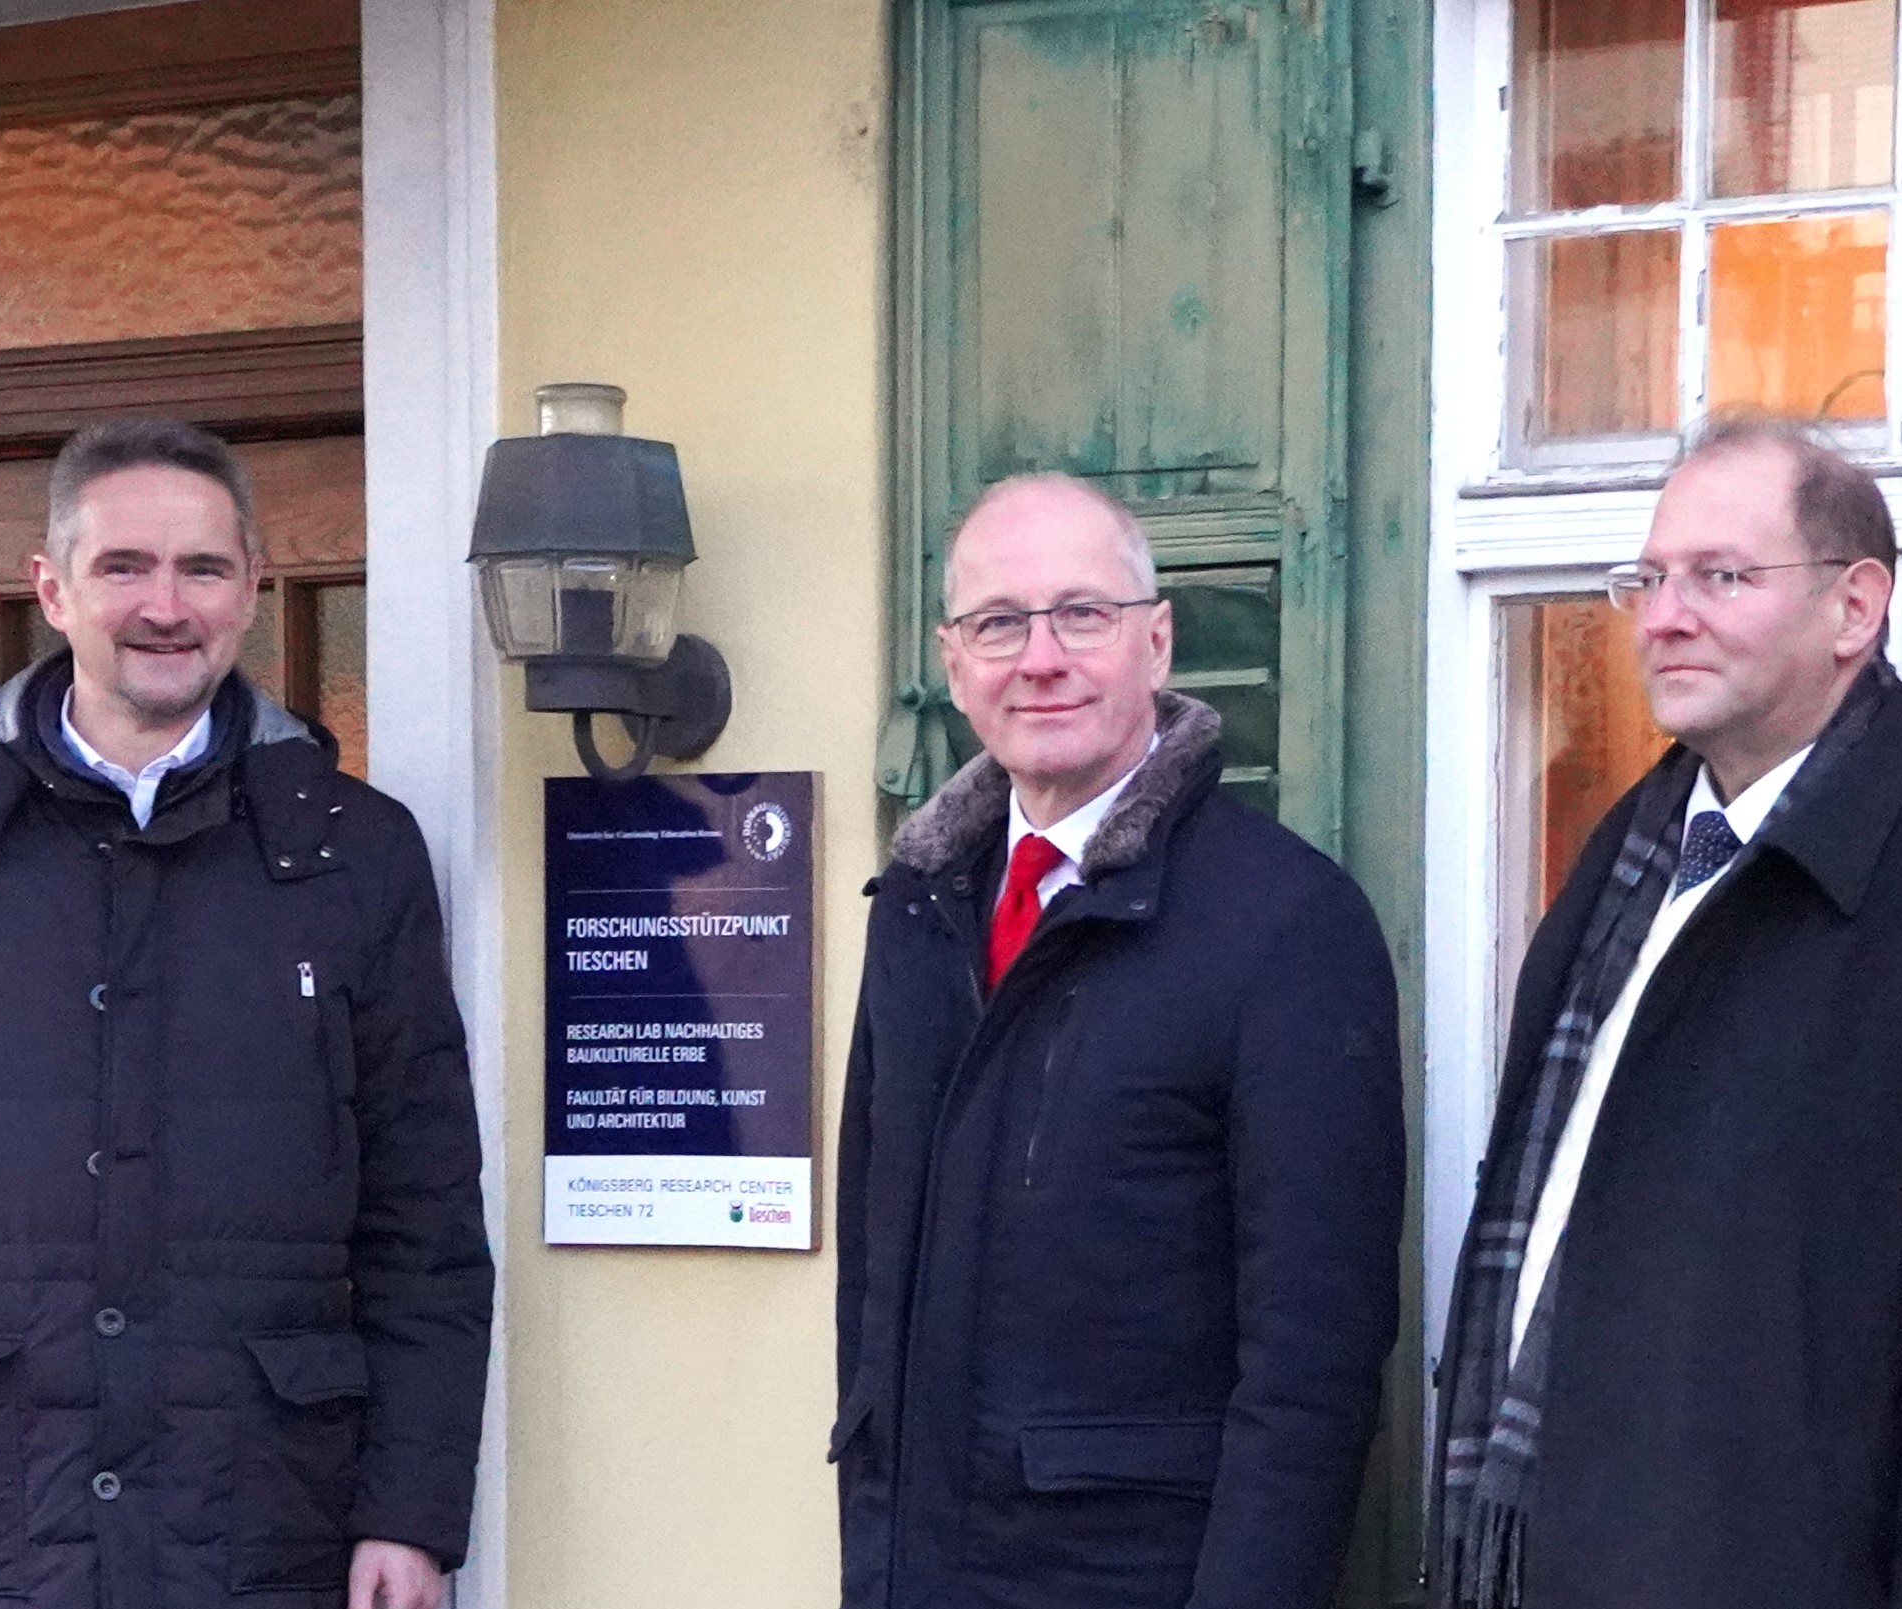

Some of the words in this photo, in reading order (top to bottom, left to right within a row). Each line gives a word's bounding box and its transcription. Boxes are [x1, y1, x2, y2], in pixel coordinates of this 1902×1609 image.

[566, 912, 791, 938] FORSCHUNGSSTÜTZPUNKT
[566, 950, 648, 971] TIESCHEN
[566, 1024, 633, 1040] RESEARCH
[636, 1023, 662, 1039] LAB
[664, 1023, 764, 1039] NACHHALTIGES
[567, 1046, 670, 1063] BAUKULTURELLE
[672, 1046, 706, 1062] ERBE
[566, 1087, 628, 1105] FAKULTÄT
[629, 1086, 655, 1105] FÜR
[657, 1089, 720, 1107] BILDUNG,
[721, 1089, 766, 1105] KUNST
[567, 1113, 595, 1129] UND
[597, 1112, 686, 1128] ARCHITEKTUR
[568, 1176, 653, 1193] KÖNIGSBERG
[660, 1179, 731, 1193] RESEARCH
[738, 1180, 792, 1194] CENTER
[568, 1204, 632, 1217] TIESCHEN
[638, 1204, 654, 1217] 72
